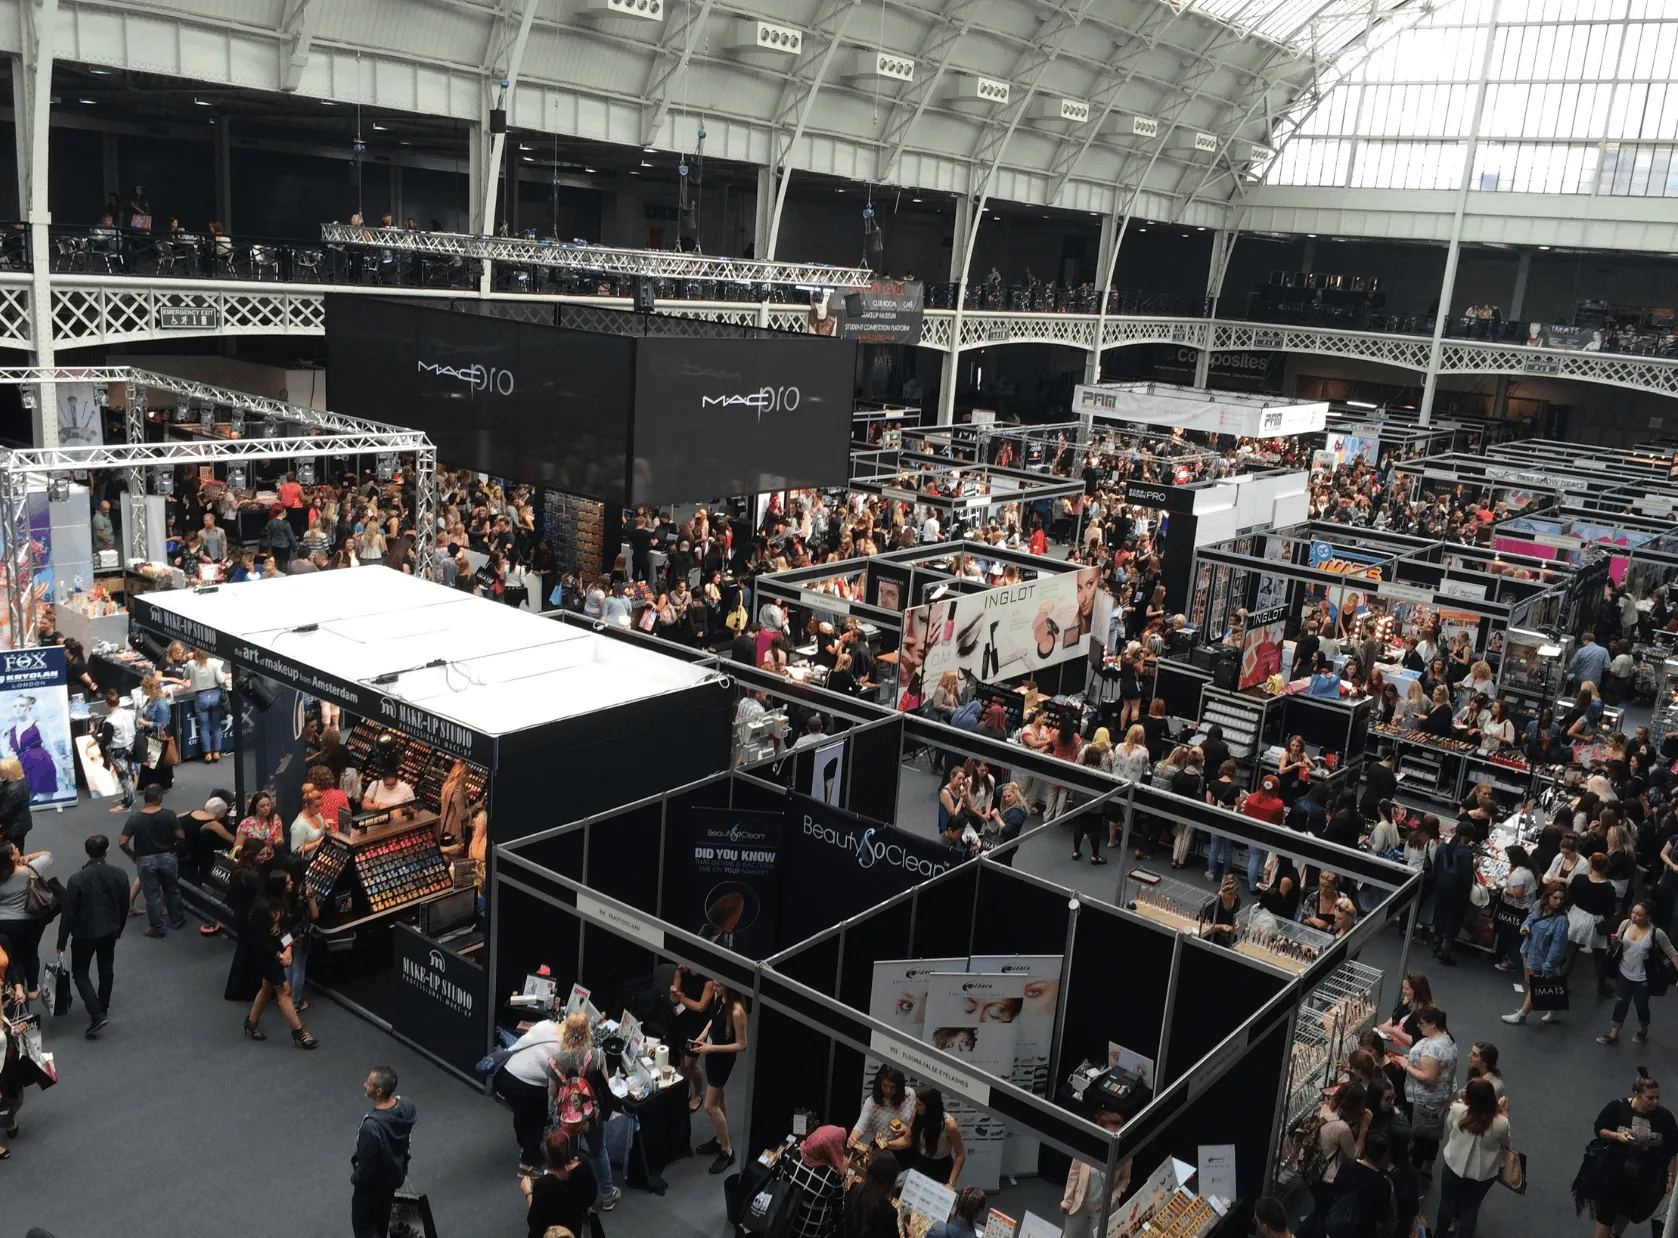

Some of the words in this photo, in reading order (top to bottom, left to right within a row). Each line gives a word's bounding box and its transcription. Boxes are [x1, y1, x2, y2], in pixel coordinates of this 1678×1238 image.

[845, 323, 864, 331] STUDENT
[891, 324, 910, 332] PLATFORM
[1551, 325, 1580, 335] IMATS
[1177, 348, 1269, 370] Coposites
[1560, 480, 1585, 490] DEALS
[1146, 491, 1166, 502] PRO
[983, 584, 1037, 609] INGLOT
[1252, 608, 1284, 626] INGLOT
[192, 622, 217, 646] STUDIO
[6, 670, 59, 683] KRYOLAN
[234, 647, 243, 657] the
[243, 647, 259, 664] art
[259, 658, 265, 666] of
[265, 658, 299, 682] makeup
[299, 673, 312, 685] from
[312, 676, 358, 704] Amsterdam
[11, 681, 46, 689] LONDON
[399, 704, 439, 735] MAKE-UP
[440, 720, 472, 749] STUDIO
[399, 722, 441, 745] PROFESSIONAL
[444, 741, 472, 757] MAKE-UP
[694, 847, 714, 859] DID
[716, 848, 739, 861] YOU
[741, 850, 776, 863] KNOW
[1497, 913, 1520, 926] IMATS
[403, 956, 441, 991] MAKE-UP
[442, 978, 472, 1010] STUDIO
[1534, 986, 1565, 996] IMATS
[403, 973, 442, 1002] PROFESSIONAL
[445, 999, 472, 1018] MAKE-UP
[902, 1050, 922, 1066] ELDORA
[922, 1061, 938, 1073] FALSE
[938, 1069, 969, 1088] EYELASHES
